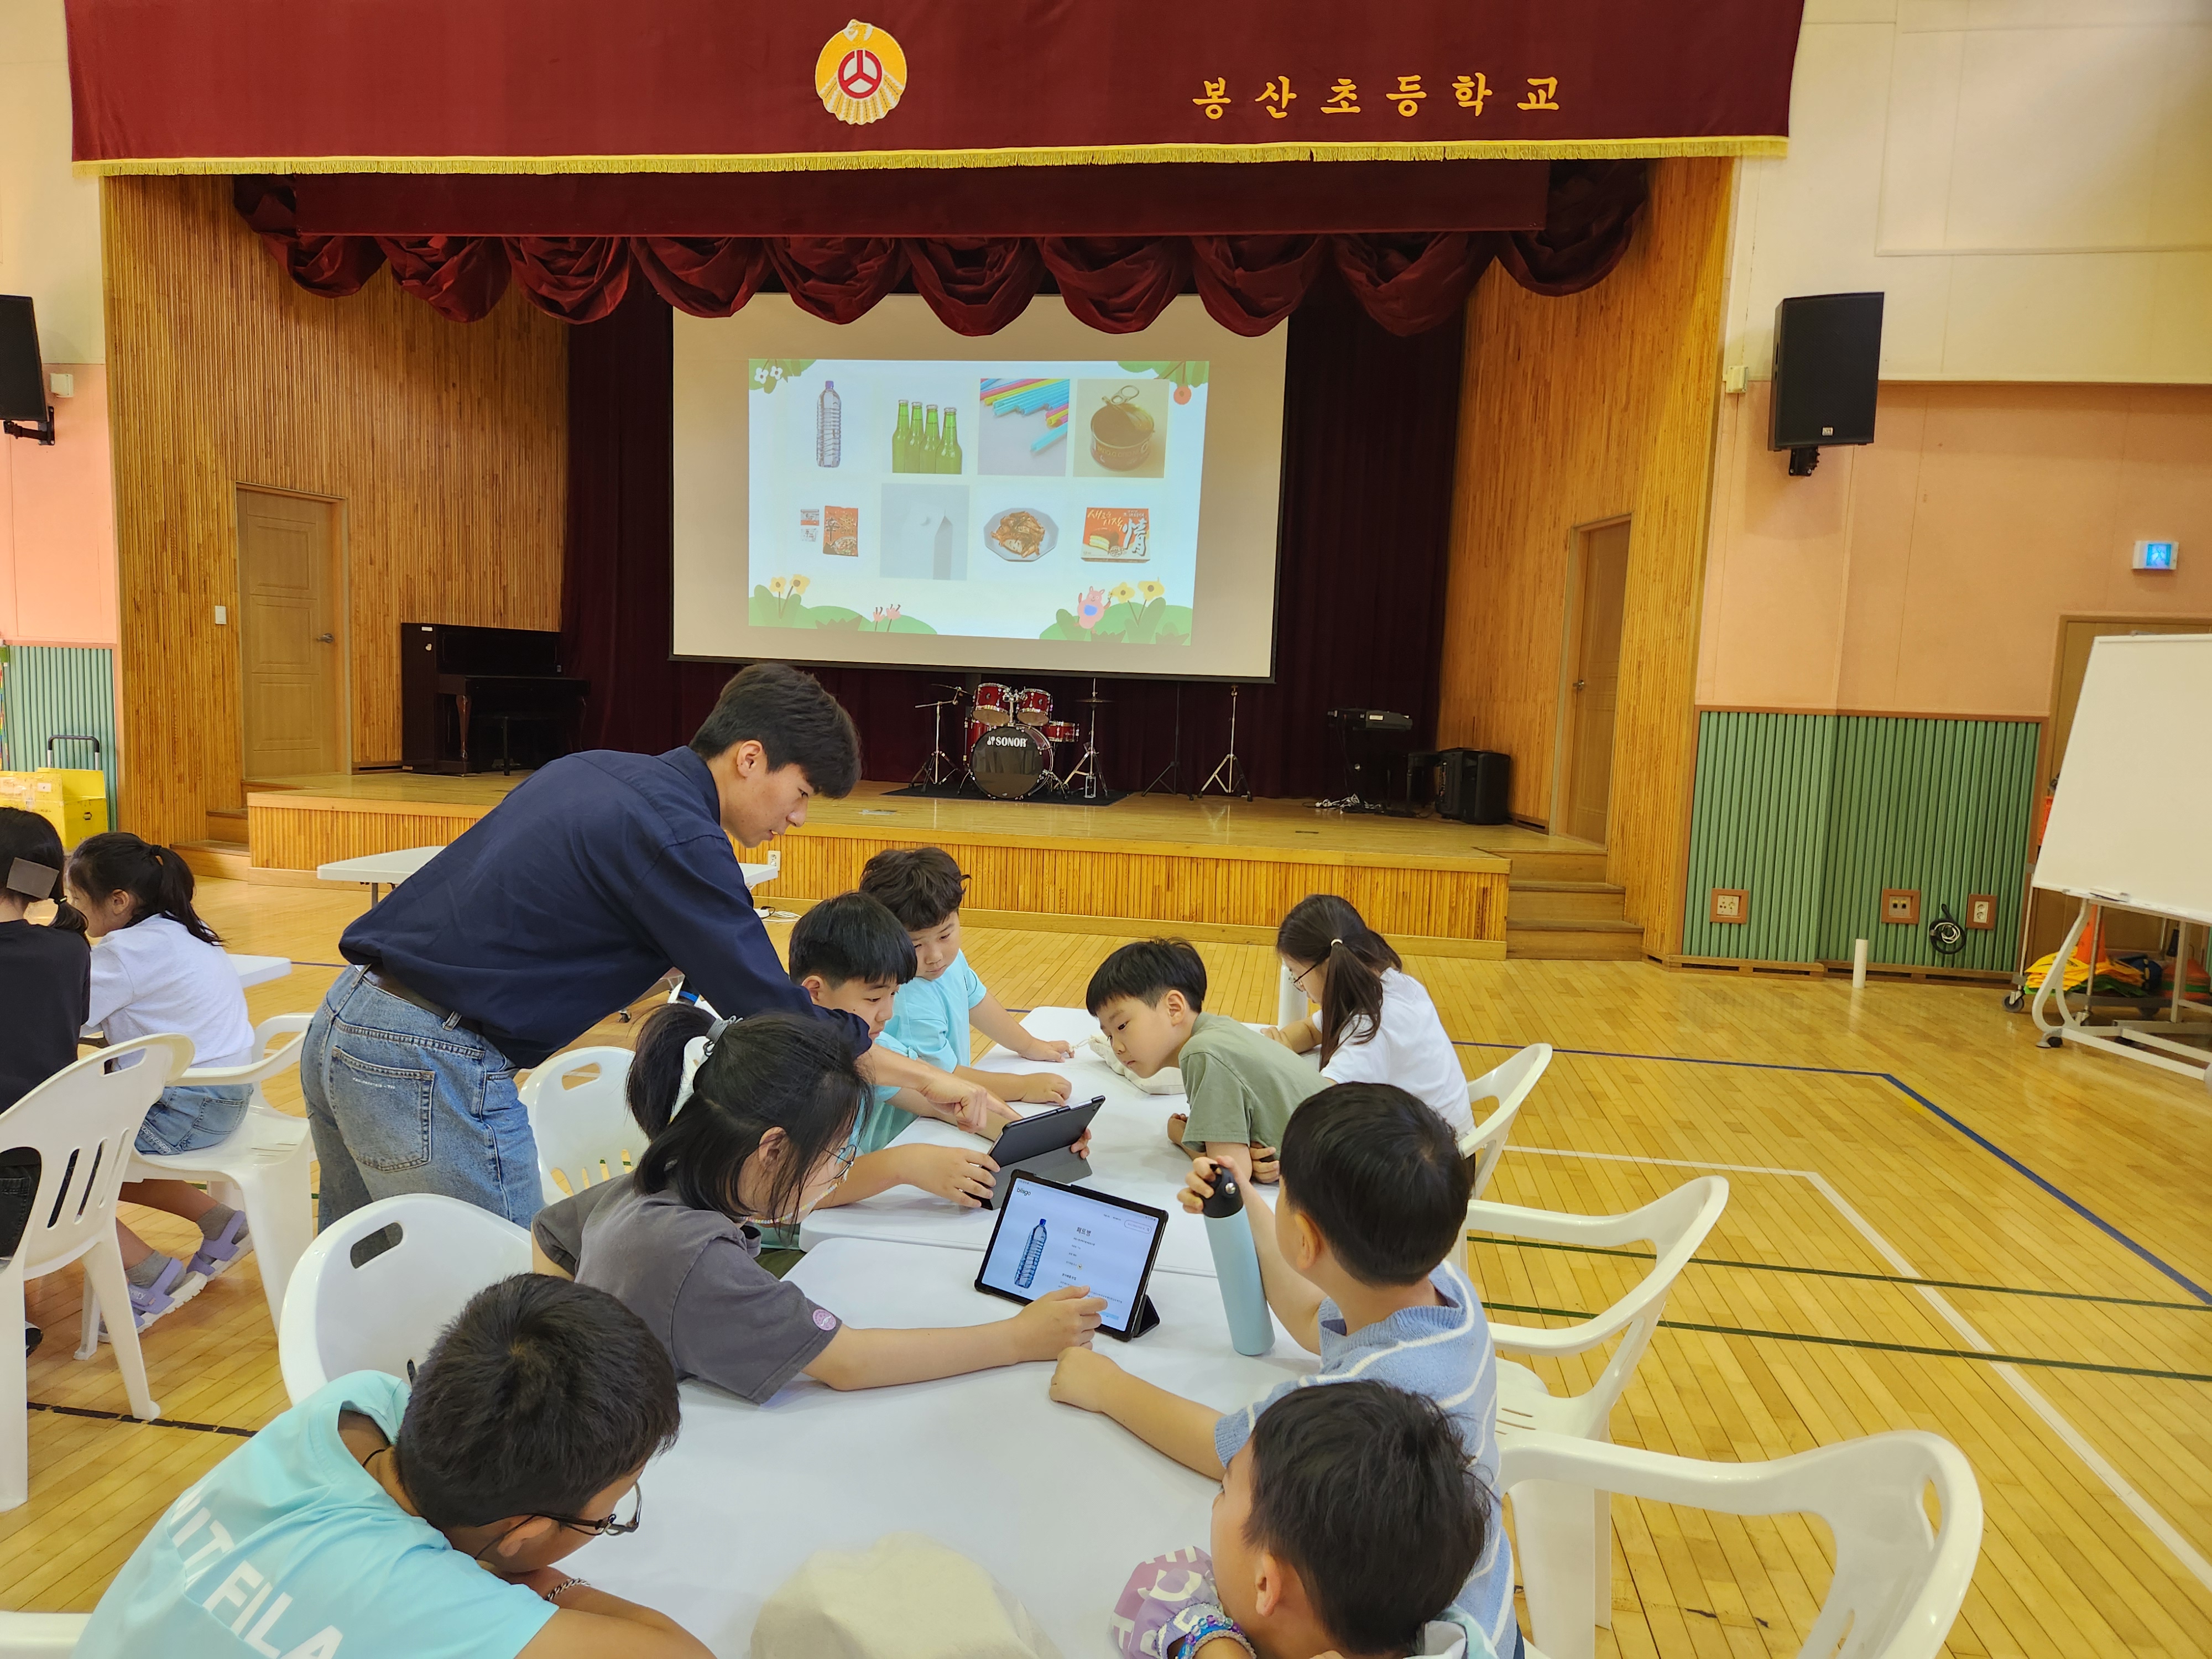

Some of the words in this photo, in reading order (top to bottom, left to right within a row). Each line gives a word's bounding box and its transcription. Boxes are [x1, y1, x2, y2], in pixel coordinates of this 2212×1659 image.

[1192, 72, 1560, 120] 봉산초등학교
[1122, 518, 1147, 557] 情
[995, 736, 1026, 748] SONOR
[202, 1560, 344, 1659] FILA
